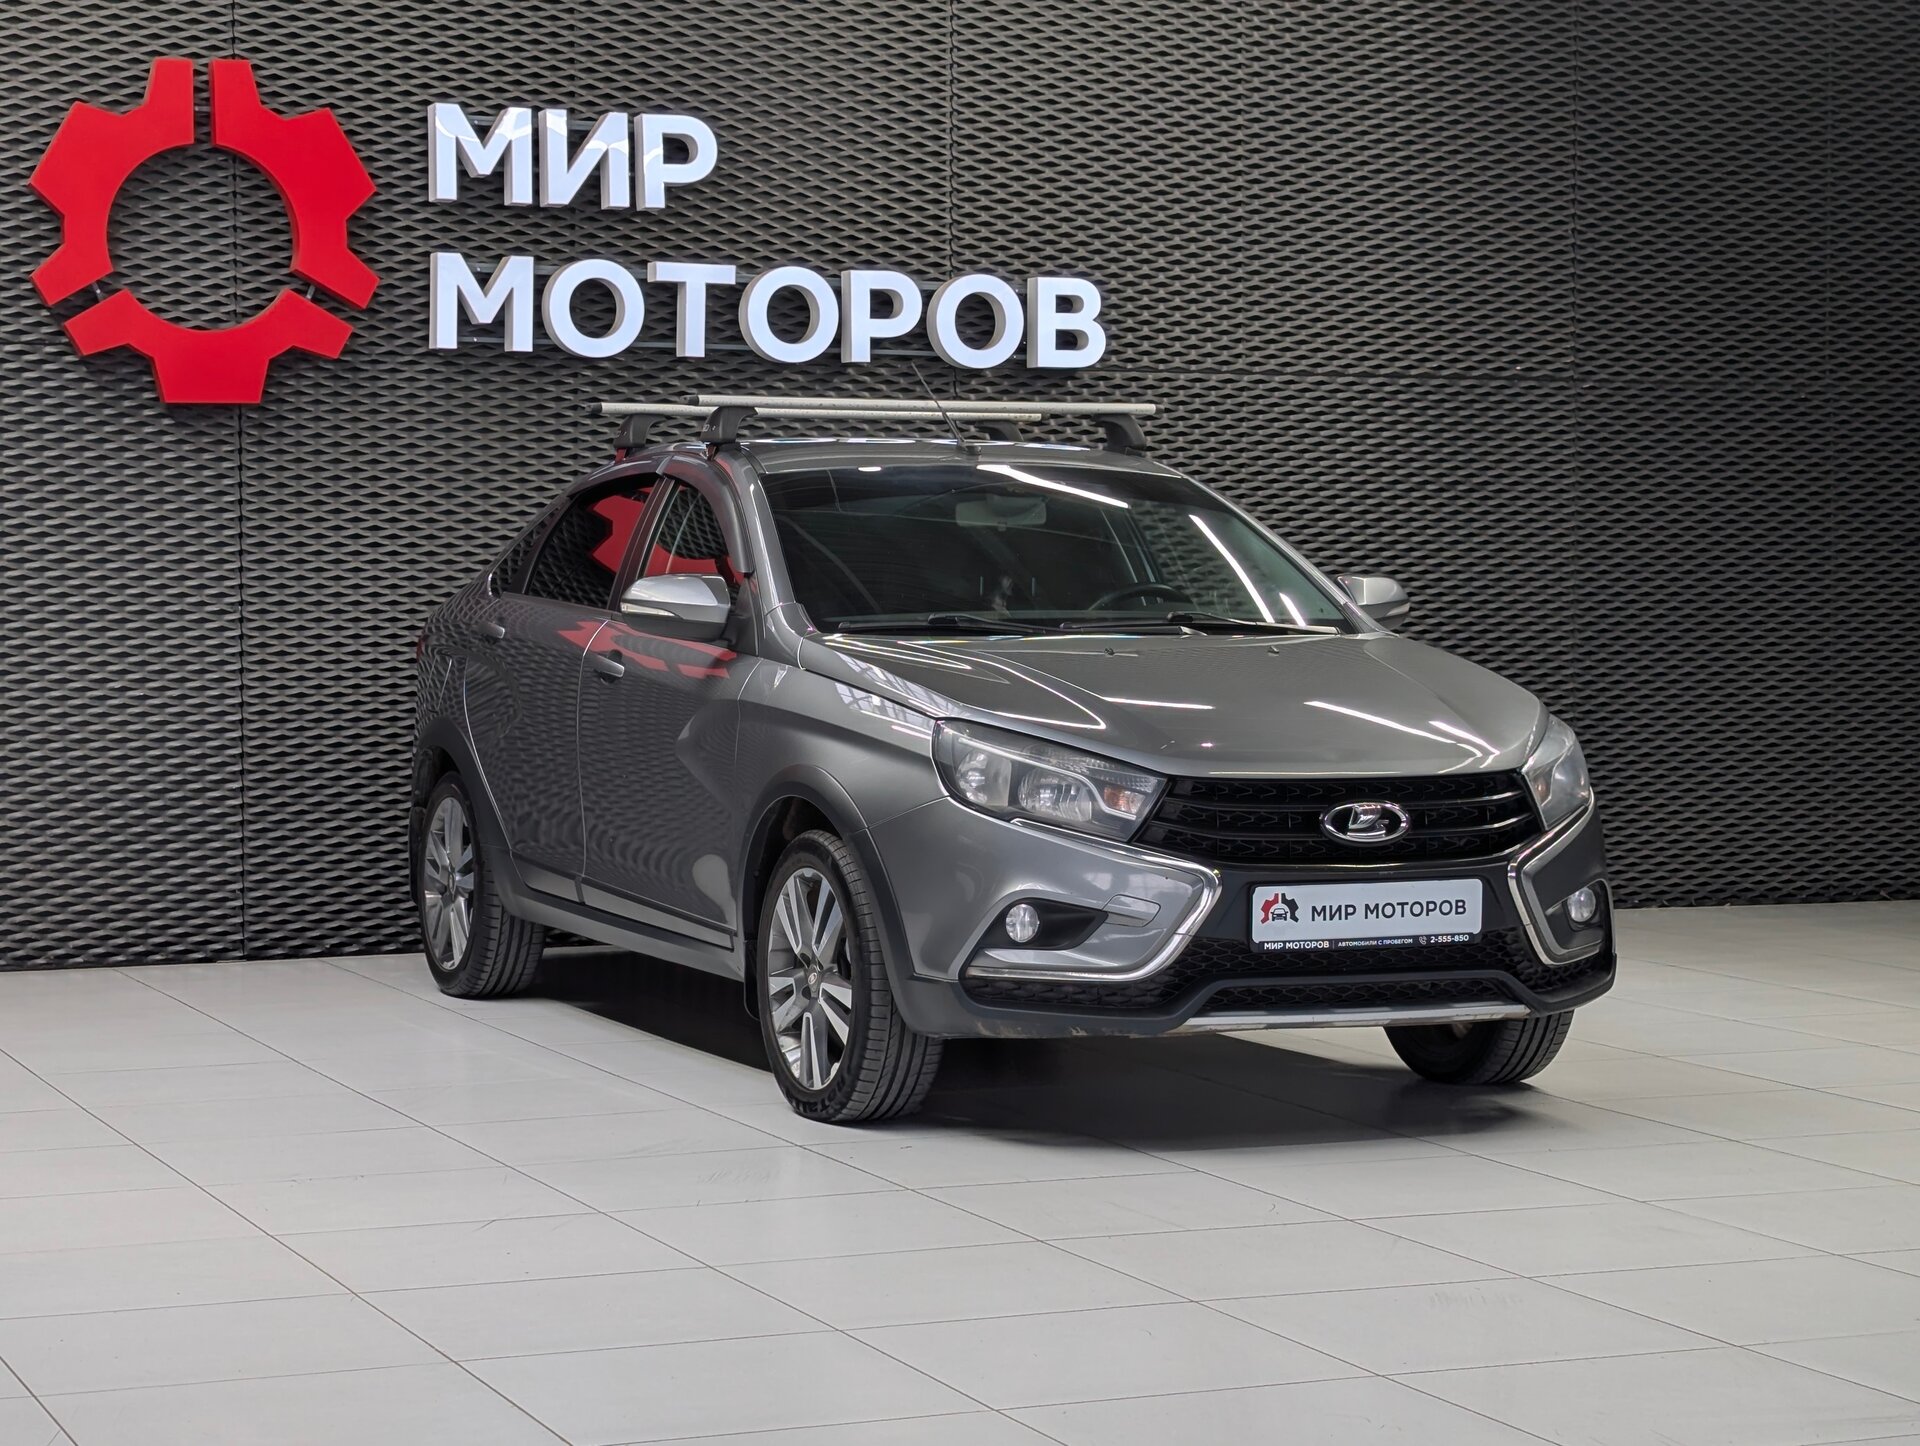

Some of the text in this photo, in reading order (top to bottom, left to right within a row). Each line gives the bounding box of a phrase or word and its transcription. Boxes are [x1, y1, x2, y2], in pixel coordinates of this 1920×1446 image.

[428, 102, 718, 211] МИР
[429, 252, 1107, 369] МОТОРОВ
[1311, 899, 1467, 921] МИР МОТОРОВ
[1264, 940, 1329, 950] МИР МОТОРОВ
[1338, 939, 1377, 947] АВТОМОБИЛИ
[1383, 937, 1413, 945] ПРОБЕГОМ
[1430, 934, 1469, 943] 2-555-850
